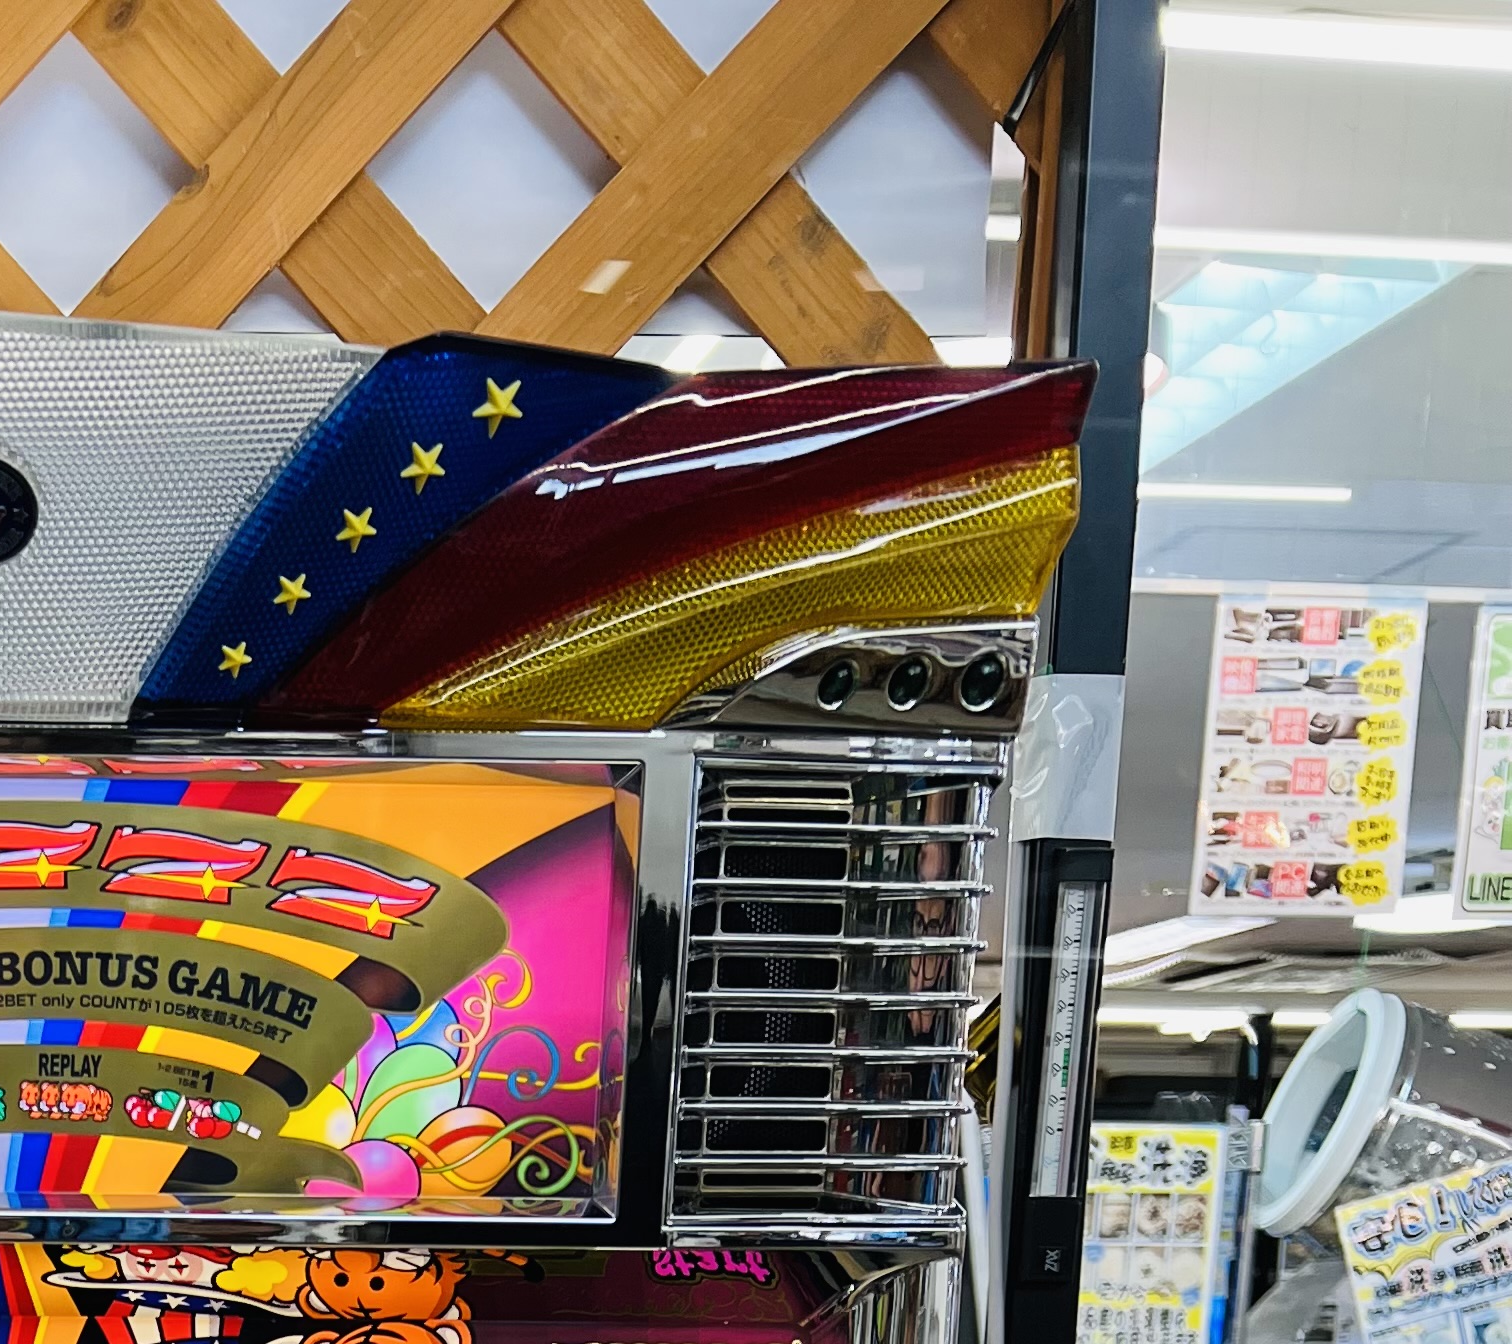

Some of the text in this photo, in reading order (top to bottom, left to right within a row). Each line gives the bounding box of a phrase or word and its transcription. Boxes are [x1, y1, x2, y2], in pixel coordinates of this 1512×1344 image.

[41, 993, 75, 1011] only
[167, 958, 318, 1031] GAME
[38, 1053, 103, 1079] REPLAY
[201, 1070, 216, 1094] 1
